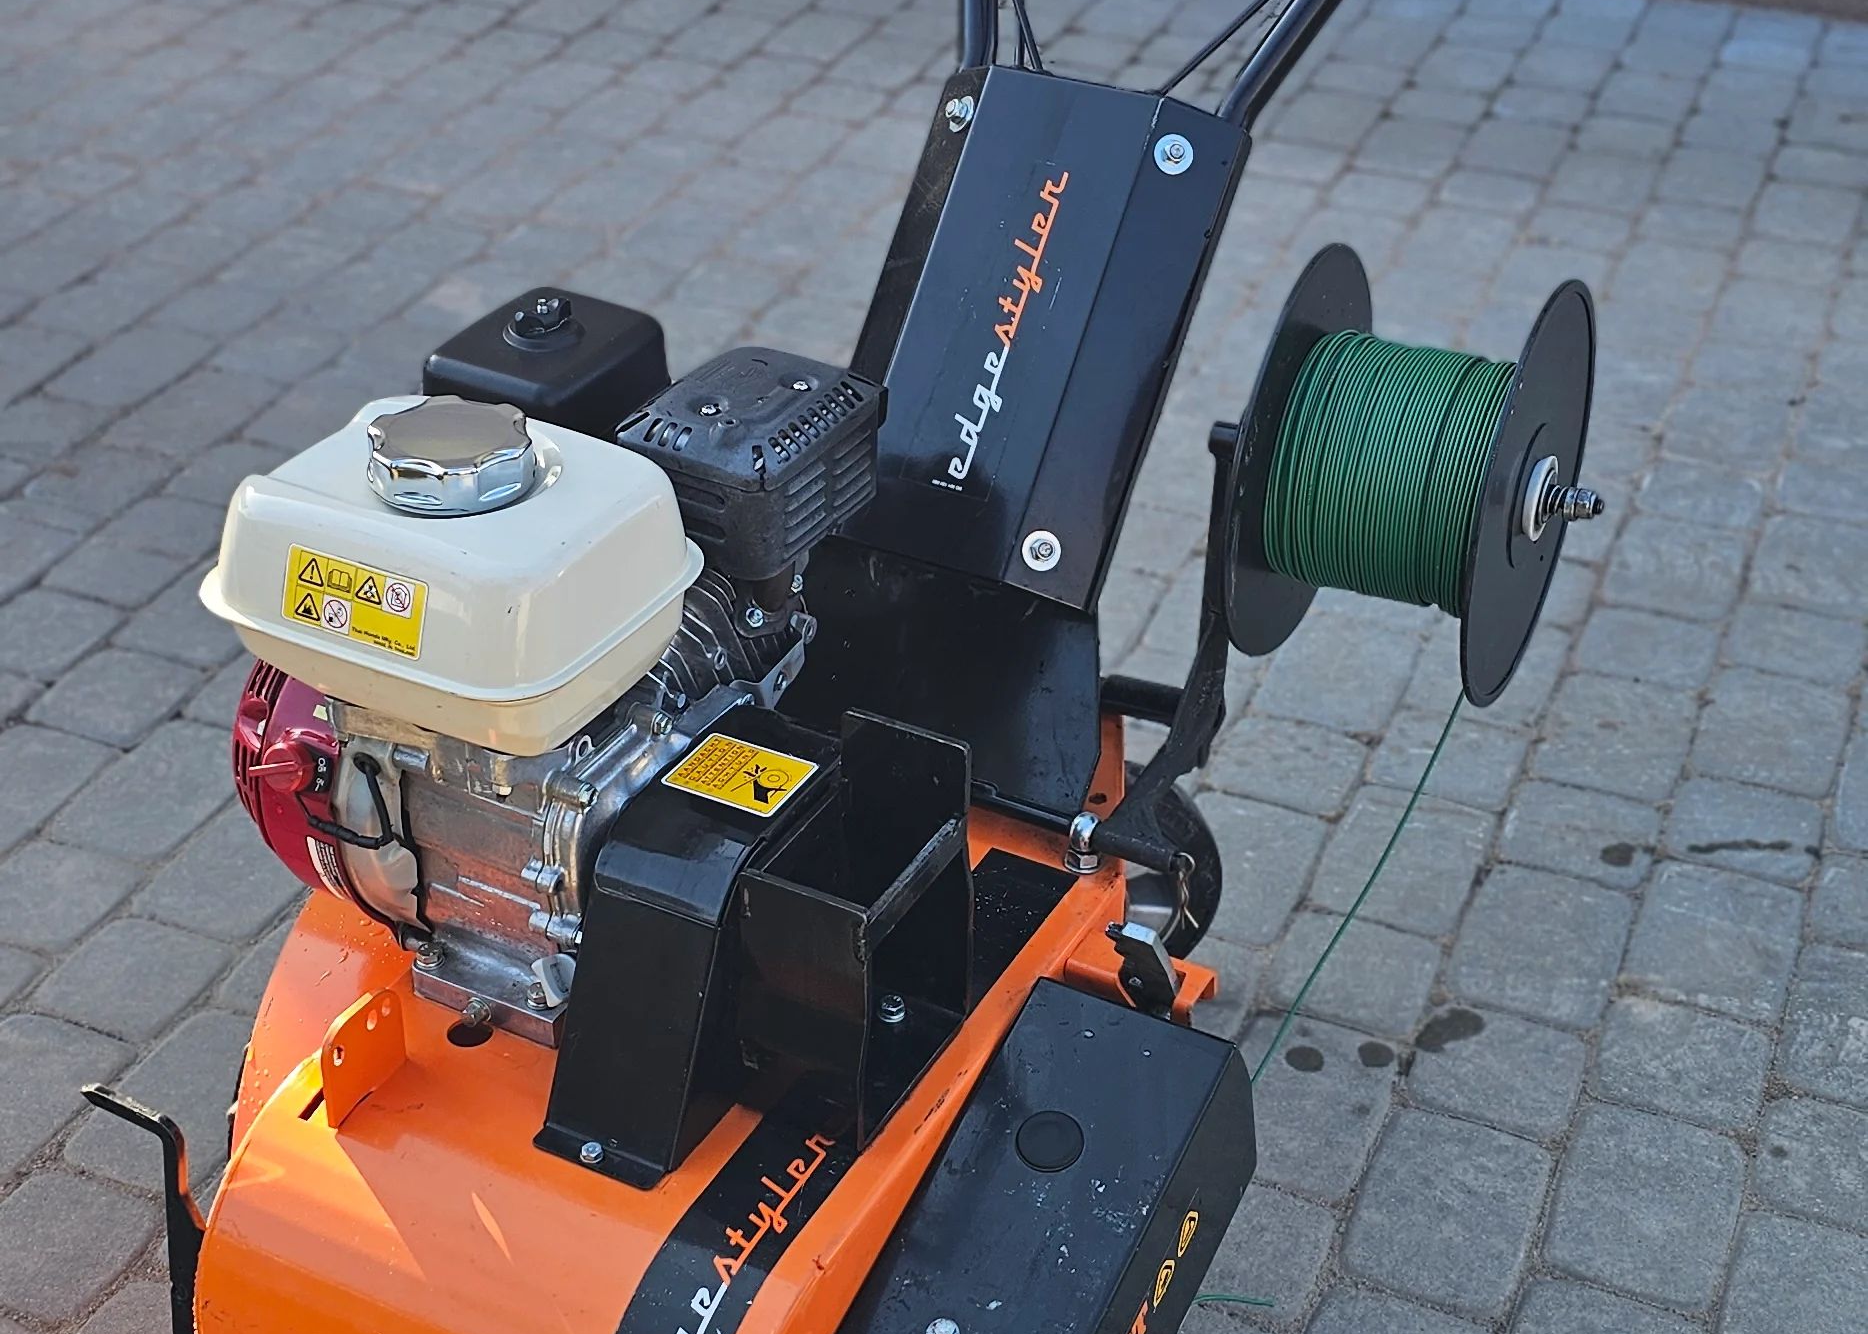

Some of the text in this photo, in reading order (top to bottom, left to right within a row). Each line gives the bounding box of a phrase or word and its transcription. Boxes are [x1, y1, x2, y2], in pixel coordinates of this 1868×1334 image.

[948, 172, 1069, 479] edgestyler
[678, 738, 720, 777] AANDACHT
[688, 742, 733, 780] CAUTION
[701, 746, 743, 785] ATTENTION
[713, 749, 754, 788] ACHTUNG
